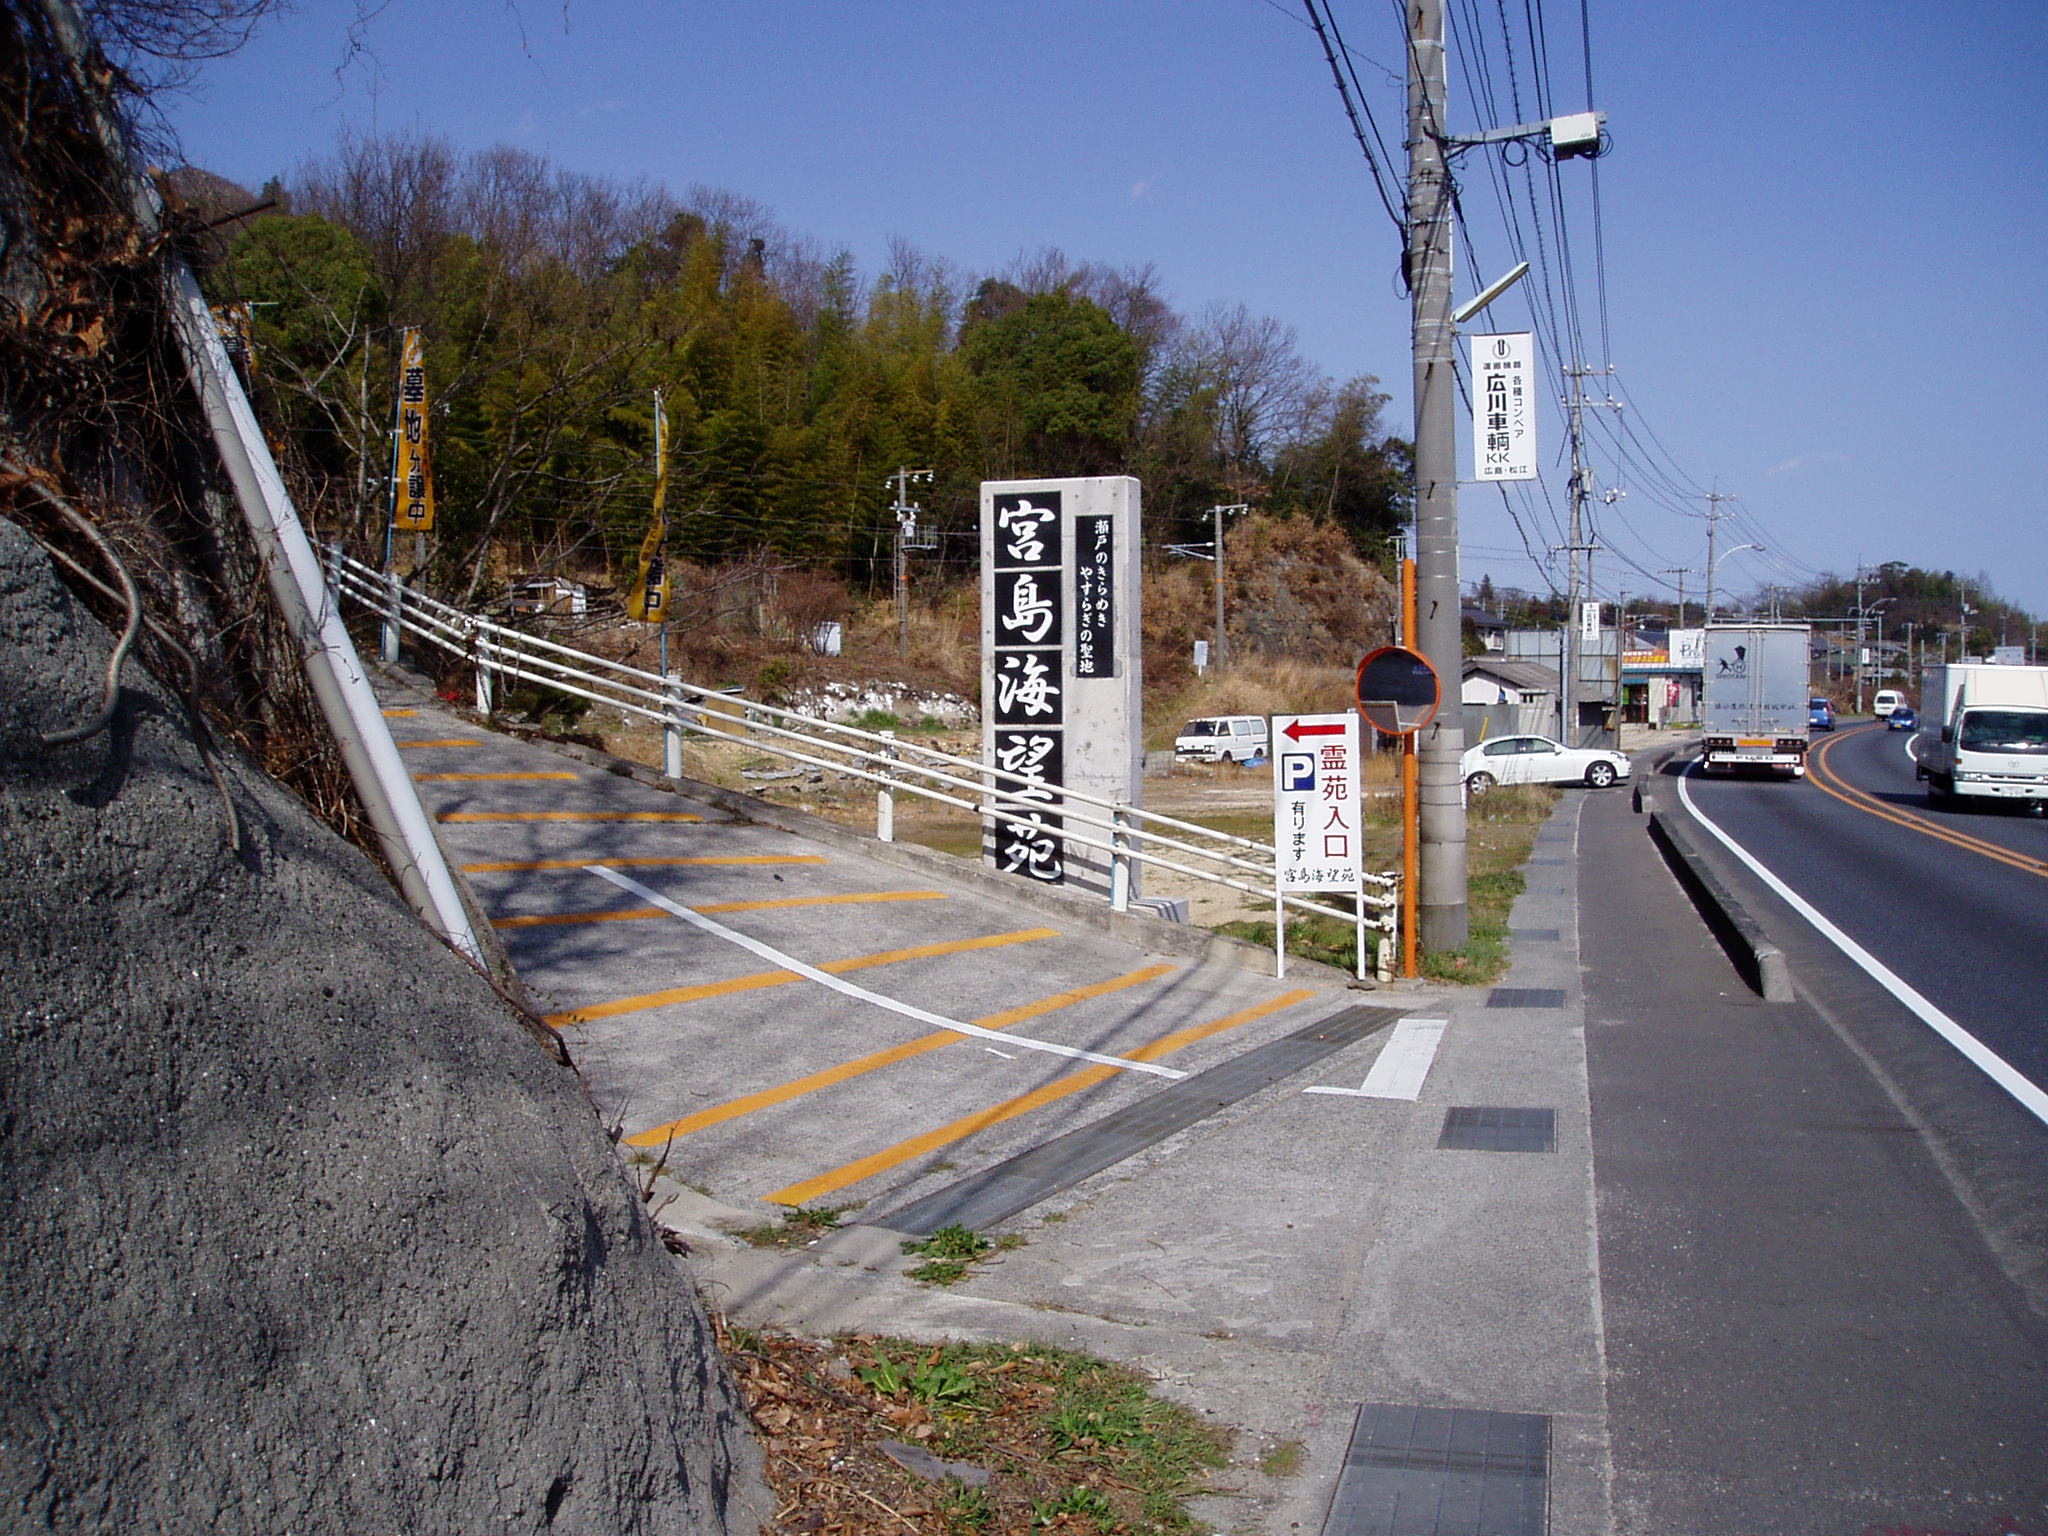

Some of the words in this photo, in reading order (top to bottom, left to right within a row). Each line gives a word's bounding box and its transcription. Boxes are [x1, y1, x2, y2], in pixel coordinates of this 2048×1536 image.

[1486, 453, 1511, 464] KK
[1094, 519, 1111, 628] 瀬戸のきらめき
[1078, 566, 1095, 674] やすらぎの聖地
[996, 499, 1063, 880] 宮島海望苑
[1283, 755, 1314, 791] P
[1320, 744, 1350, 858] 霊苑入口
[1291, 800, 1306, 861] 有ります
[1284, 867, 1356, 884] 宮島海望苑
